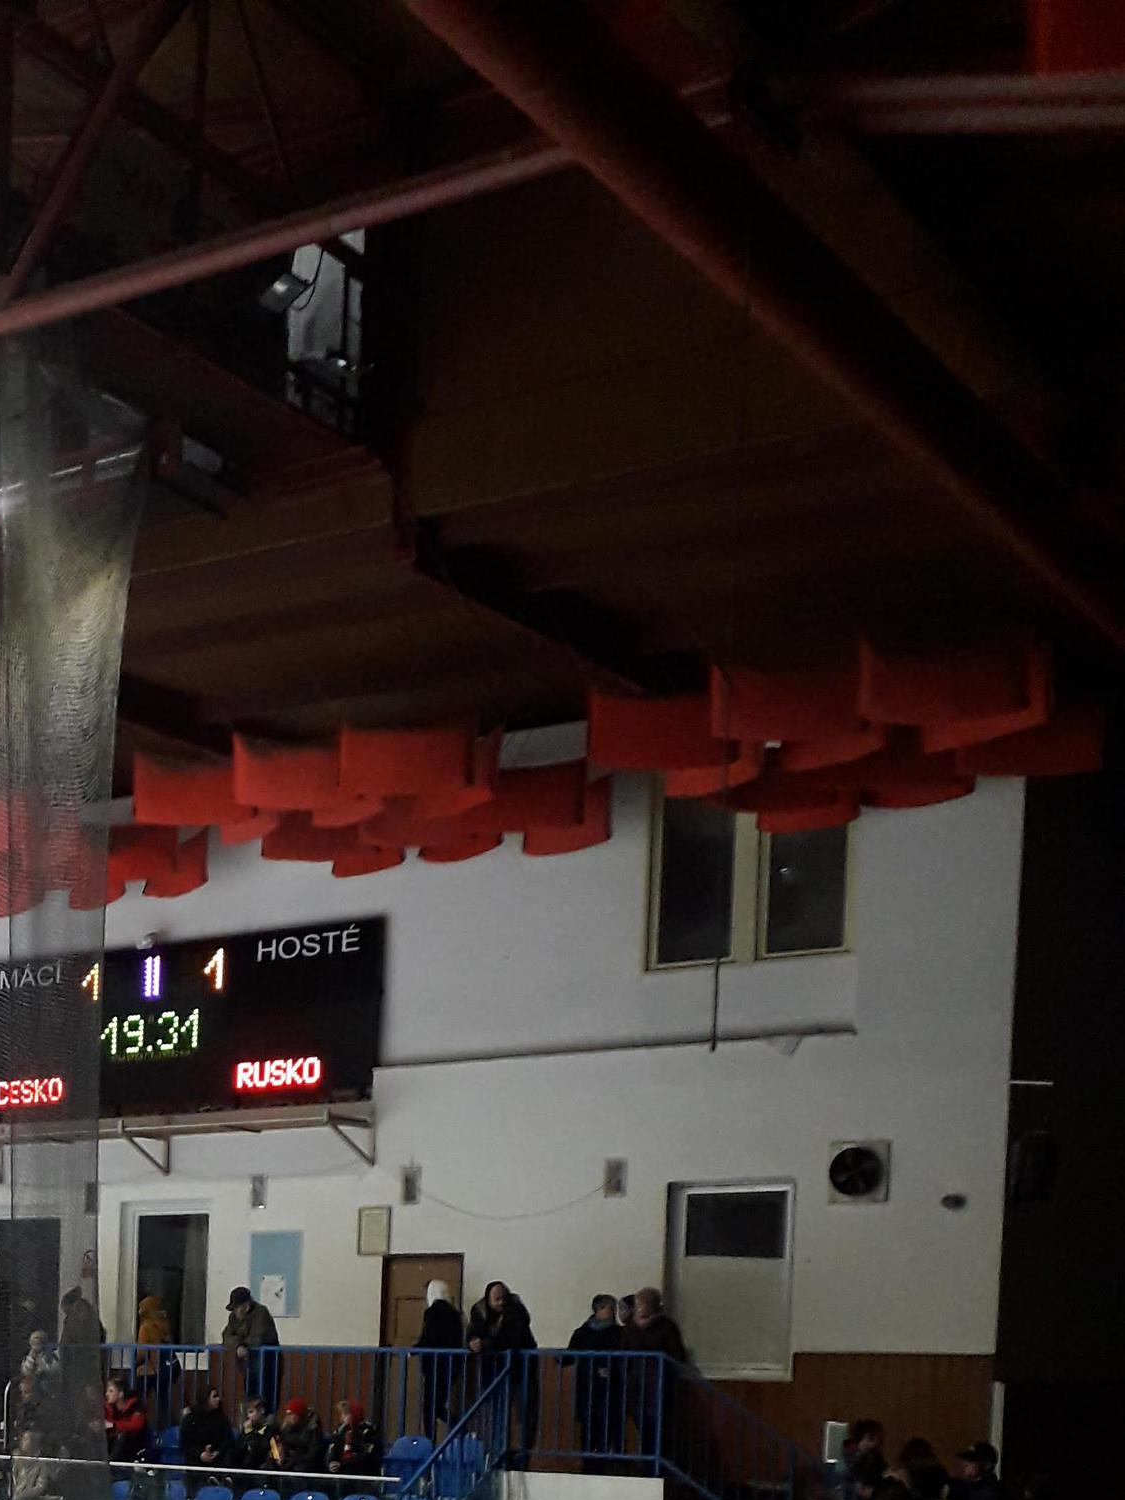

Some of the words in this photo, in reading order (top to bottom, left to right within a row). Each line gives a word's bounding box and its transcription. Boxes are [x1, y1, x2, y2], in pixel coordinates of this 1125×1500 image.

[257, 924, 361, 962] HOSTÉ
[81, 962, 100, 1001] 1
[204, 947, 225, 990] 1
[236, 1057, 321, 1090] RUSKO
